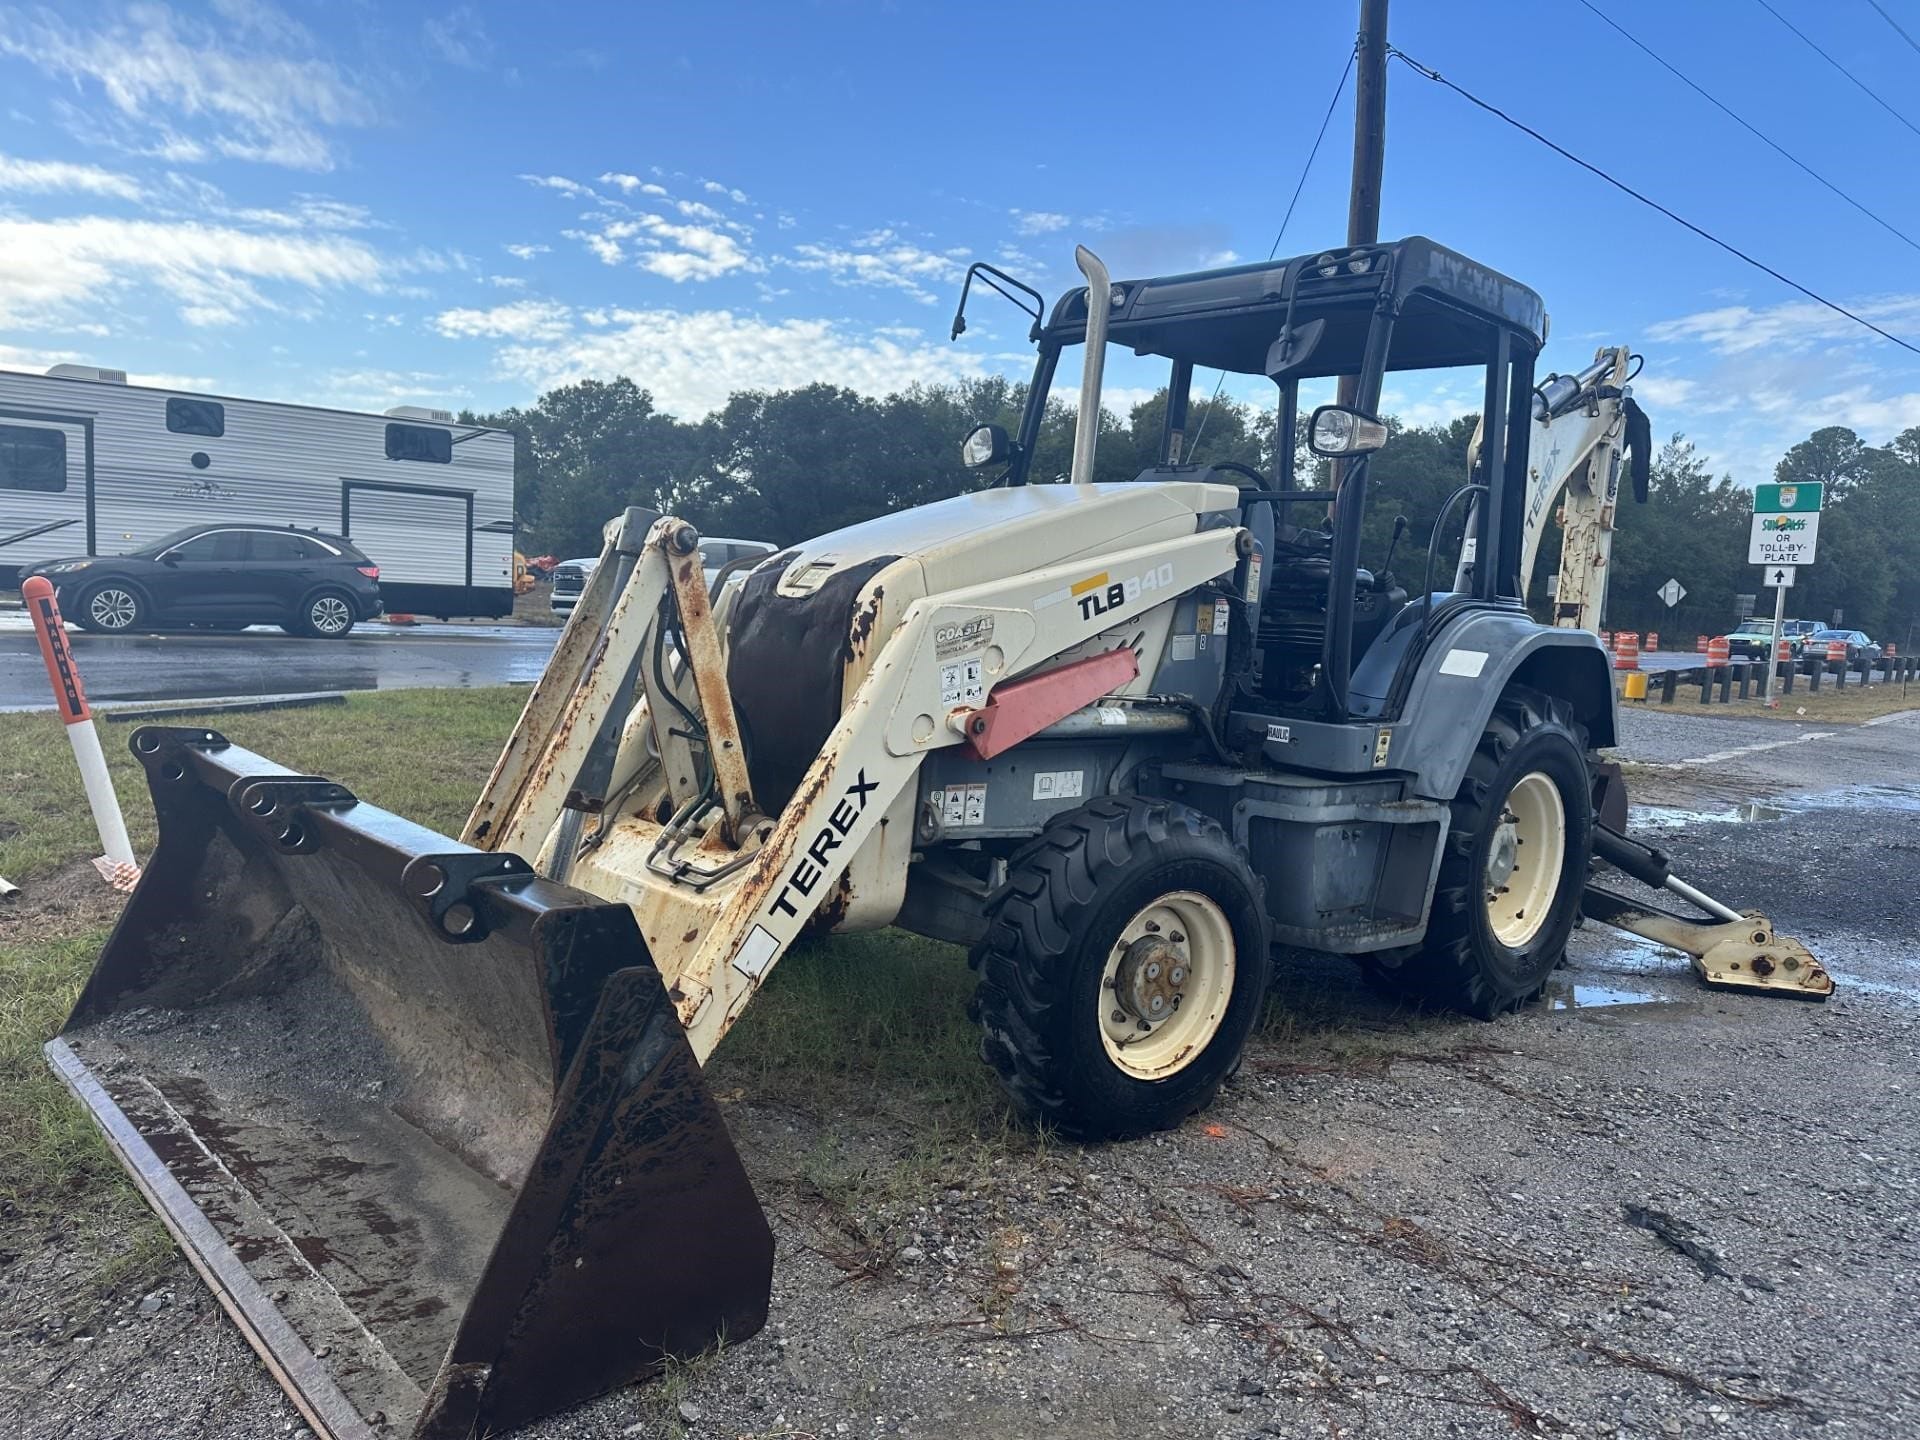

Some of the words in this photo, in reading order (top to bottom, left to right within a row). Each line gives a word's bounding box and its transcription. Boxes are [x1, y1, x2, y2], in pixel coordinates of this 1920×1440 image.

[1526, 440, 1560, 529] TEREX
[1776, 534, 1791, 542] OR
[1760, 543, 1807, 552] TOLL-BY-
[1764, 553, 1799, 562] PLATE
[936, 618, 993, 643] COASTAL
[768, 766, 880, 918] TEREX
